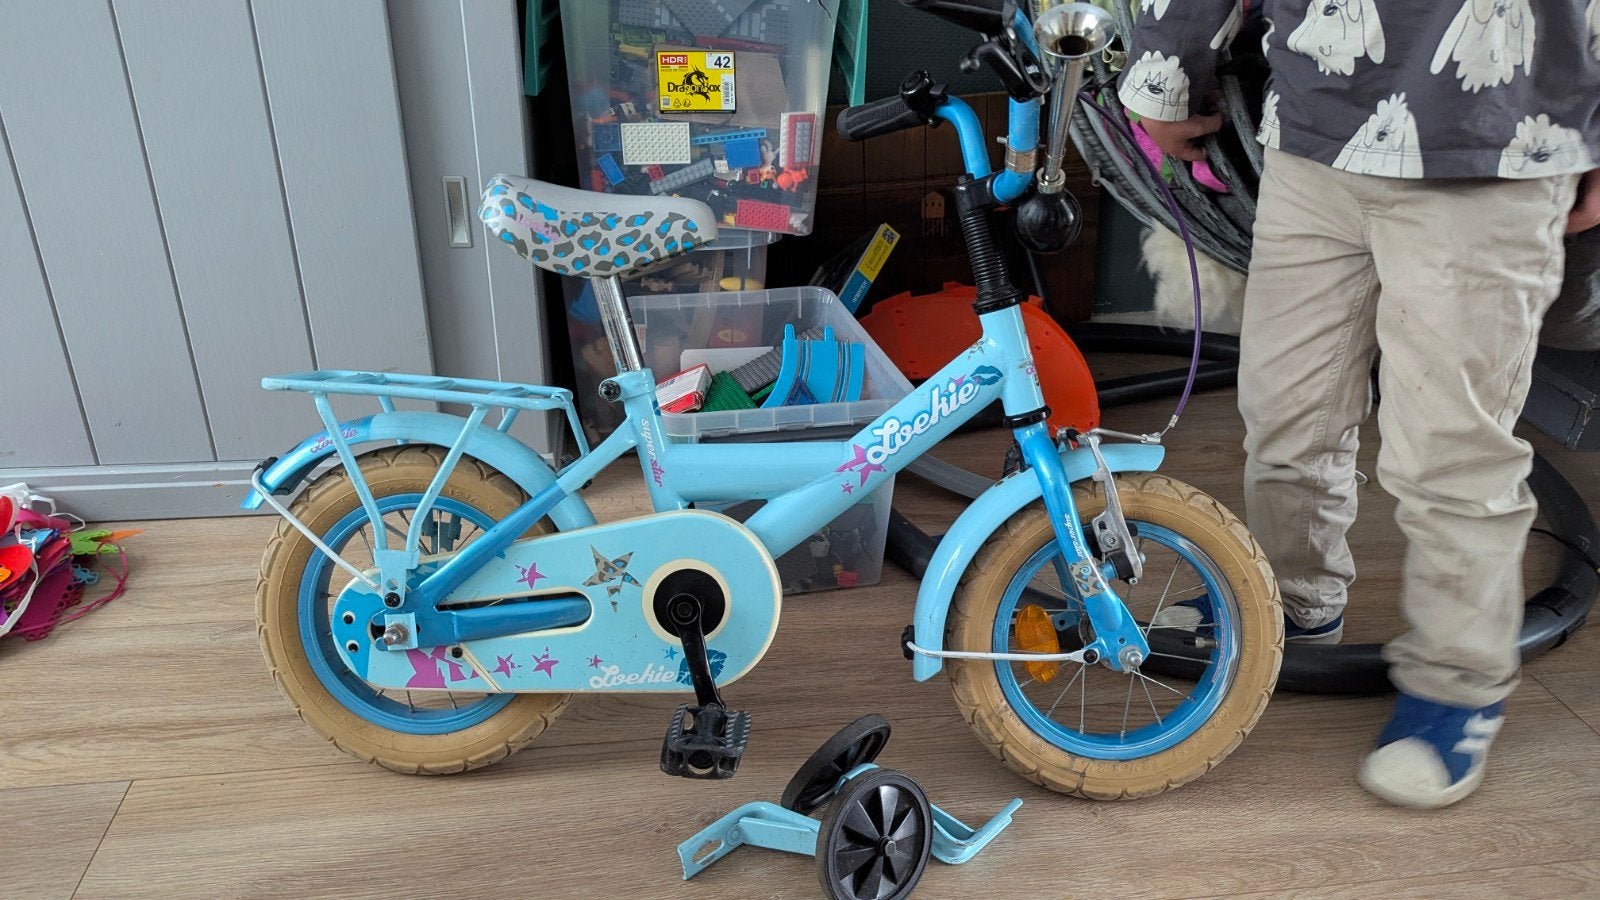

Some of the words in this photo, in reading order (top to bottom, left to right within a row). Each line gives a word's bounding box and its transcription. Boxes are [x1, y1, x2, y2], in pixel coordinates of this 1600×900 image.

[714, 56, 731, 68] 42
[668, 82, 721, 95] DragonBox
[865, 380, 981, 466] Loekie
[641, 418, 665, 488] superstar
[1064, 513, 1085, 560] superstar
[589, 662, 677, 689] Loekie
